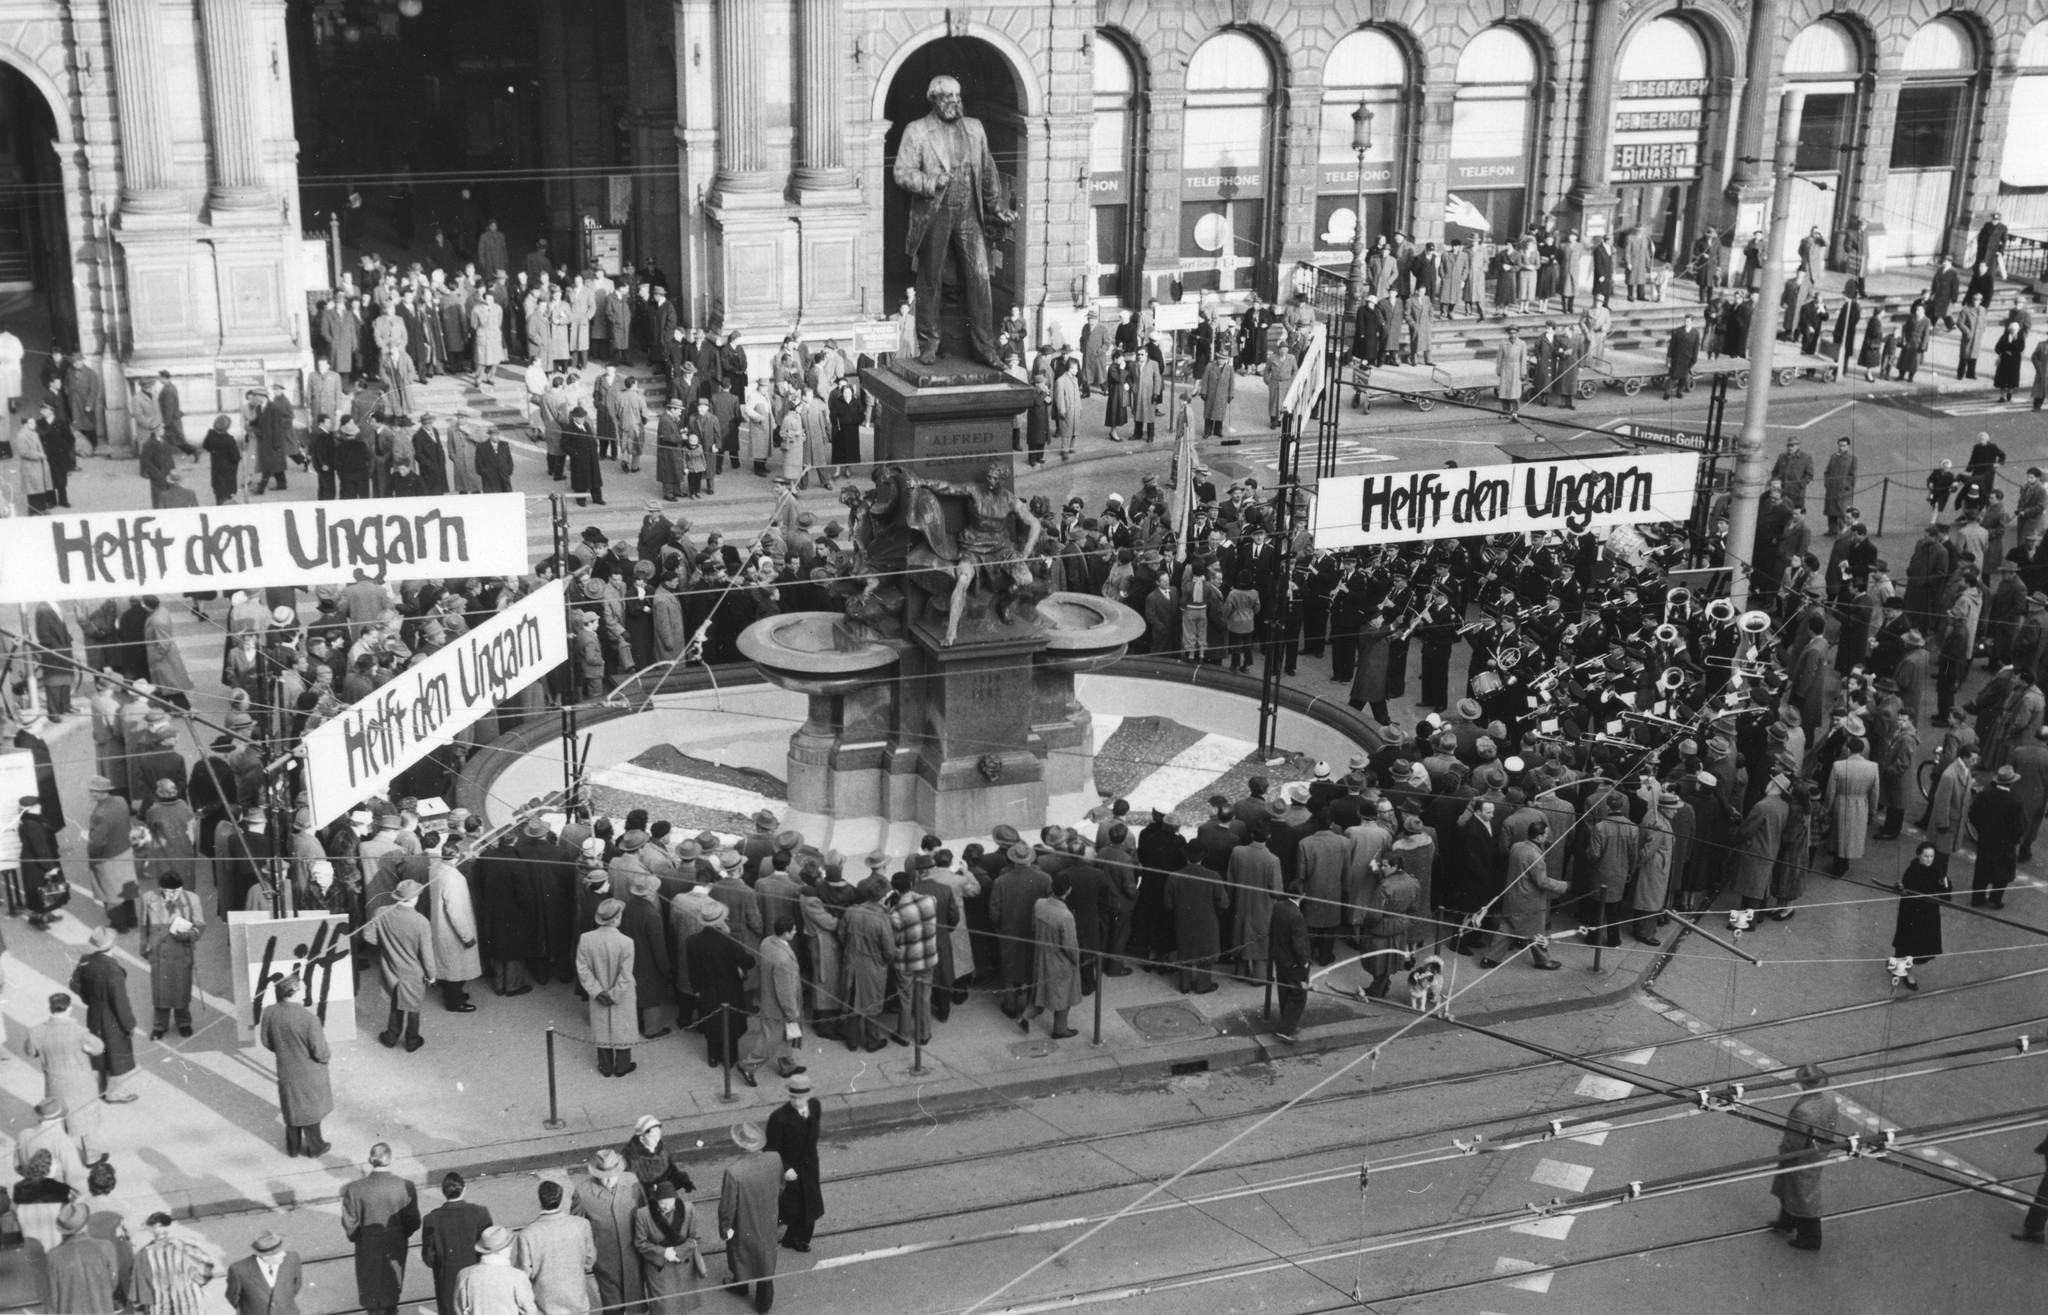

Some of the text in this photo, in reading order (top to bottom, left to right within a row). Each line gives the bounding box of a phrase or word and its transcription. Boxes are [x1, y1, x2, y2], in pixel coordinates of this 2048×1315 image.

[1186, 175, 1261, 188] TELEPHONE
[1325, 170, 1391, 182] TELEFONO
[1459, 166, 1515, 177] TELEFON
[932, 432, 994, 446] ALFRED
[1635, 426, 1723, 453] Luzern-Gotthd
[1361, 465, 1653, 534] Helft den Ungarn
[52, 507, 470, 586] Helft den Ungarn
[343, 613, 543, 789] Helft den Ungarn
